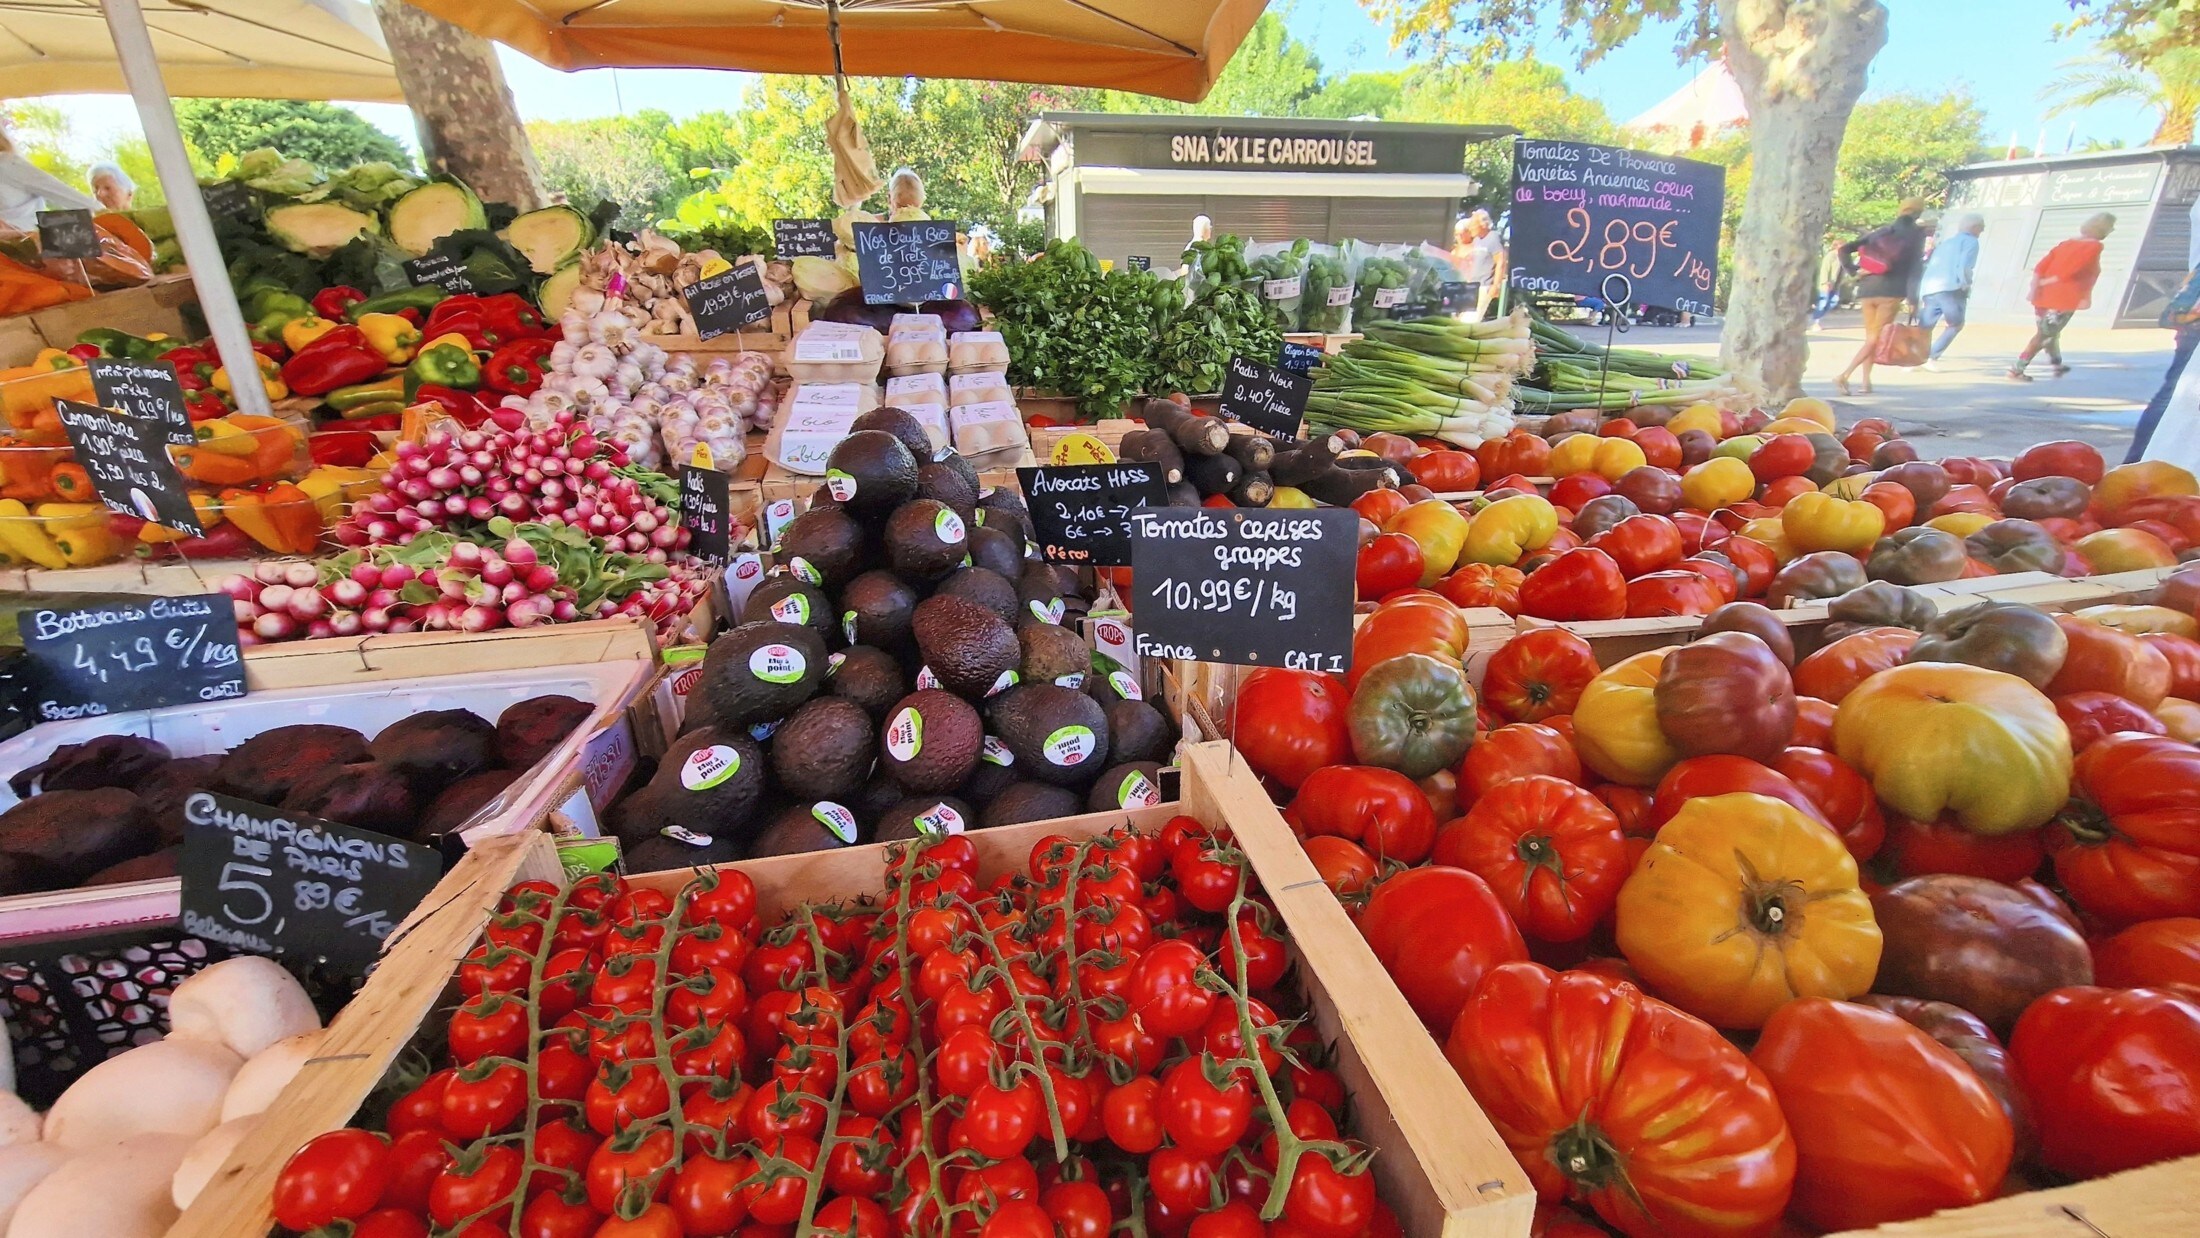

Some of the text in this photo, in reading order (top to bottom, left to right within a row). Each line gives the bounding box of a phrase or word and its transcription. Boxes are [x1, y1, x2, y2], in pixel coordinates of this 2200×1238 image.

[1171, 135, 1377, 165] SNACK LE CARROUSEL
[1515, 141, 1676, 175] Tomates De Provence
[1516, 186, 1535, 202] de
[1517, 163, 1694, 200] Variétés Anciennes coeur
[777, 243, 786, 254] 5
[859, 226, 887, 255] Nos
[879, 249, 894, 264] de
[684, 285, 699, 299] Ail
[1511, 267, 1560, 292] France
[1675, 297, 1699, 312] CAT
[1233, 358, 1293, 390] Radis Noir
[1032, 469, 1150, 497] Avocats HASS
[1065, 524, 1087, 540] 6€
[1132, 511, 1323, 541] Tomates cerises
[1046, 544, 1089, 560] Pérou
[1213, 546, 1303, 571] grappes
[736, 561, 760, 579] TROPS
[1098, 624, 1125, 645] TROPS
[1136, 633, 1197, 660] France
[1284, 650, 1323, 672] CAT
[233, 835, 272, 862] DE
